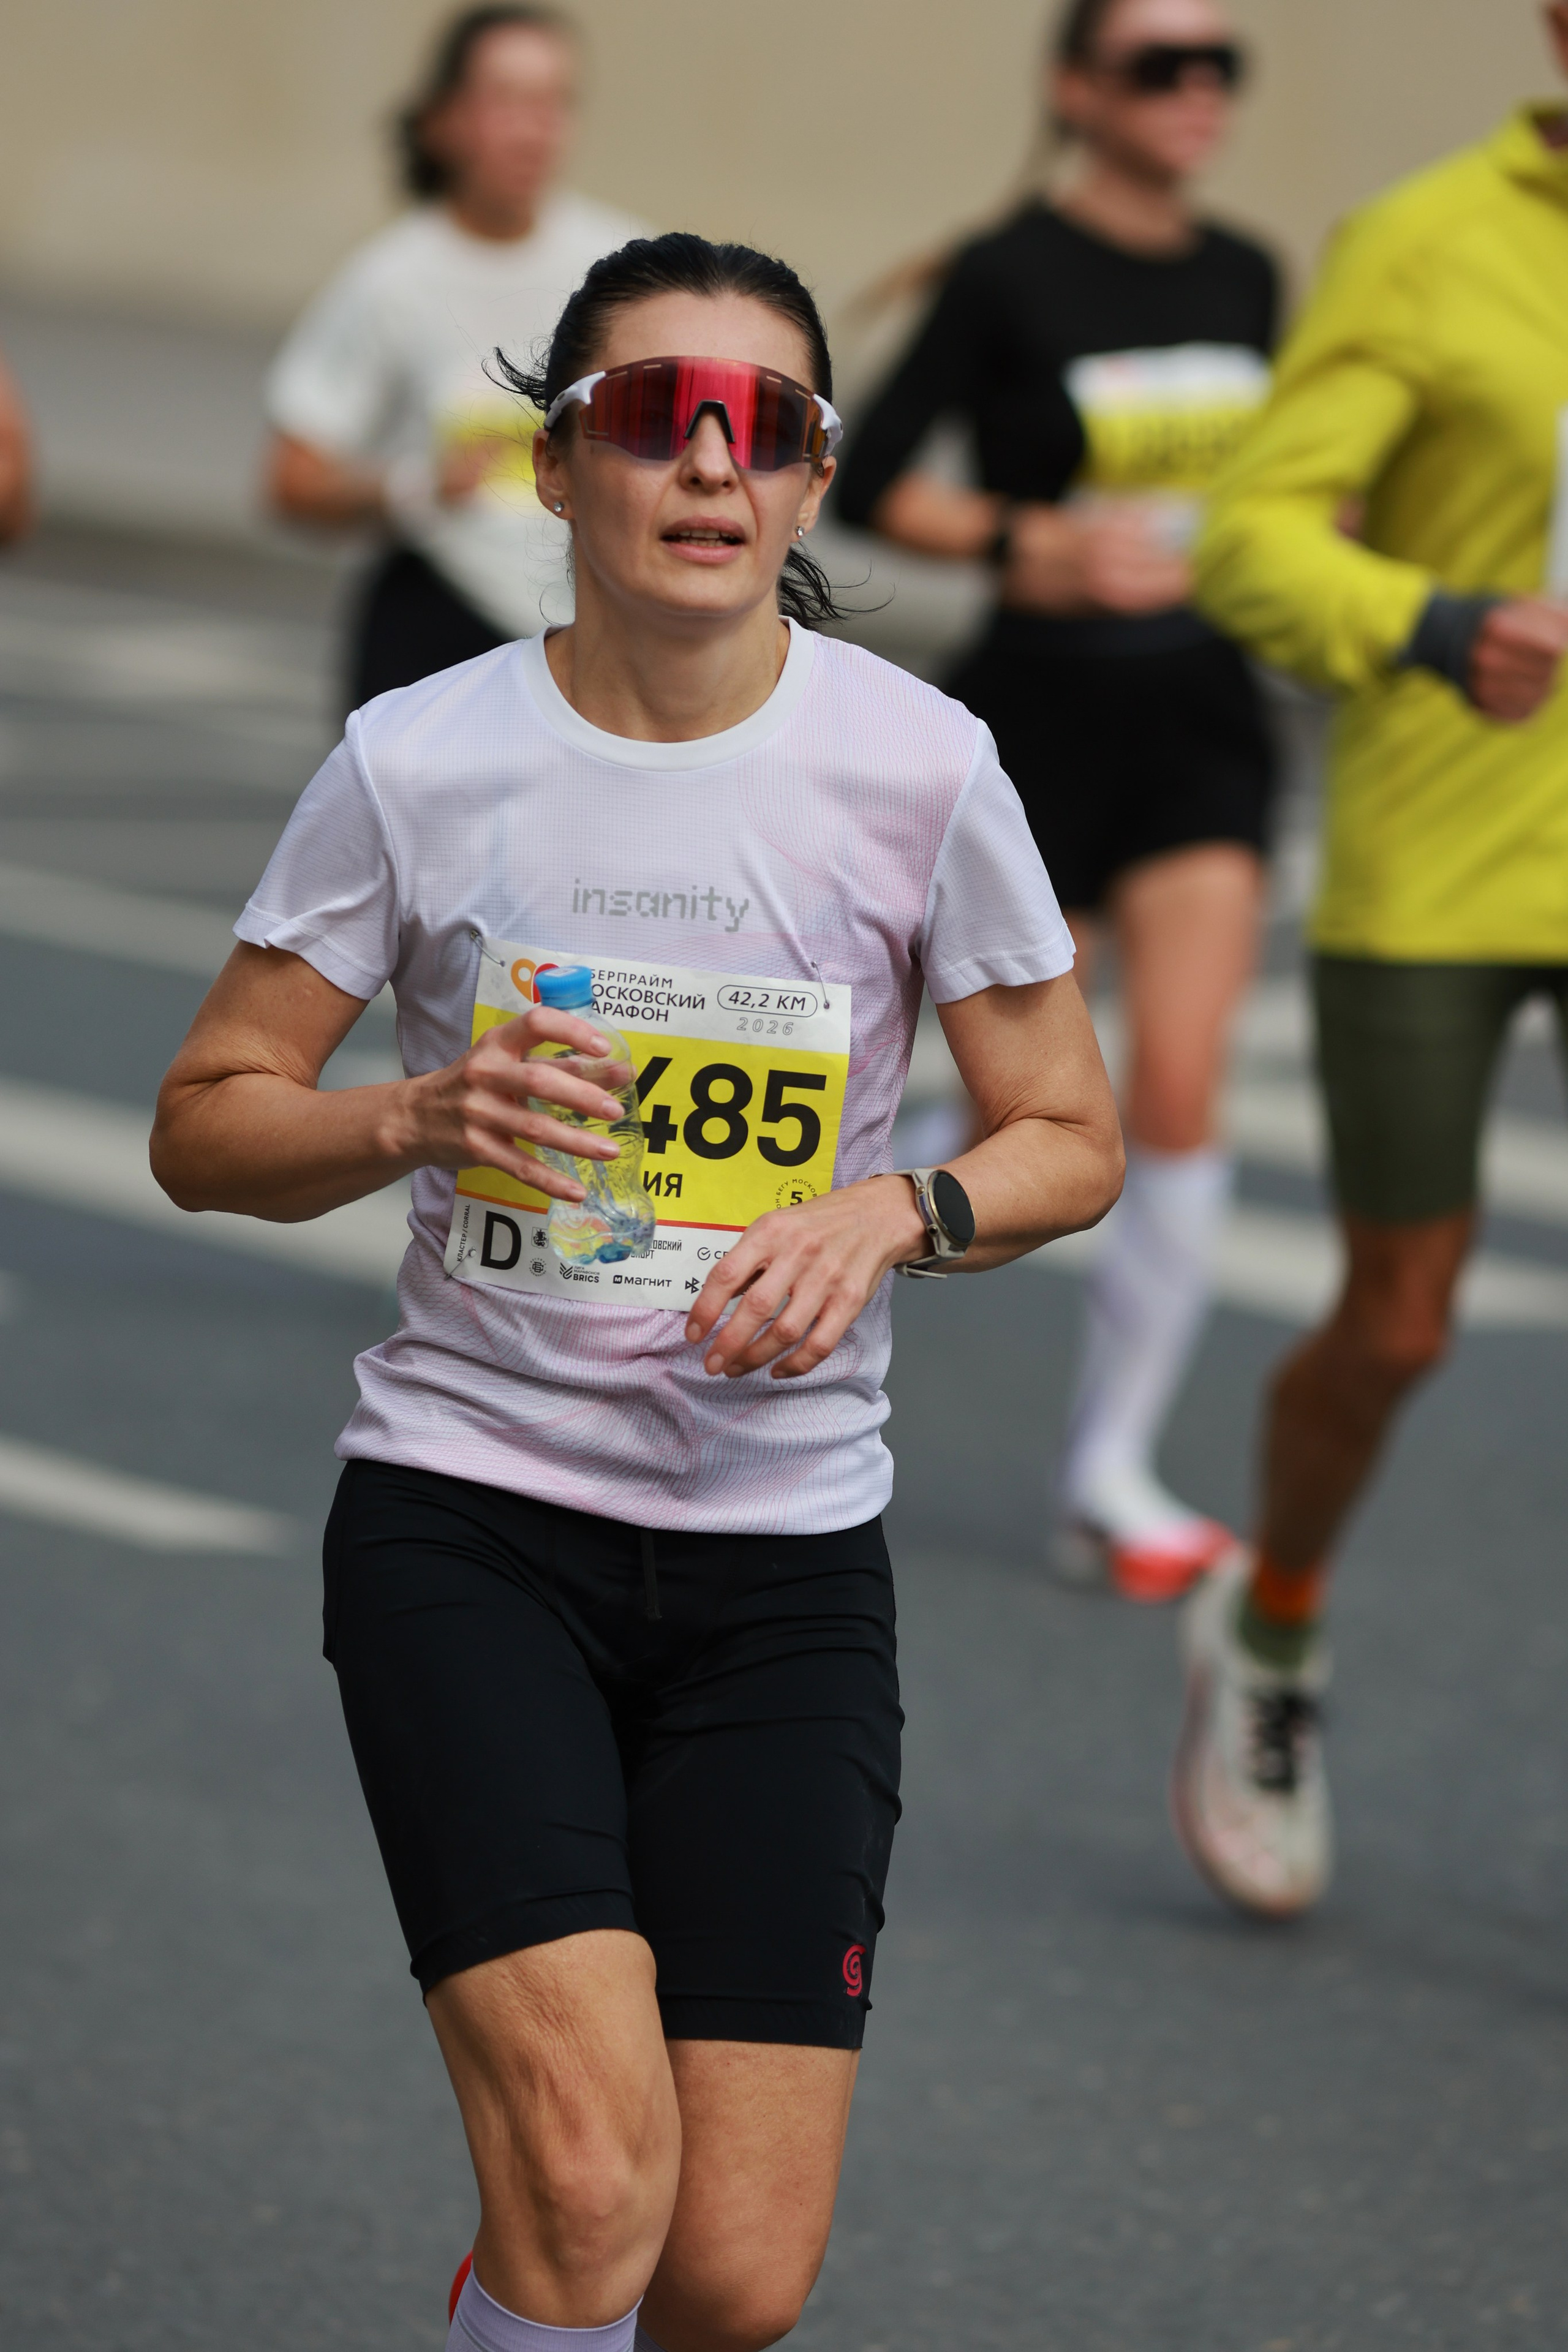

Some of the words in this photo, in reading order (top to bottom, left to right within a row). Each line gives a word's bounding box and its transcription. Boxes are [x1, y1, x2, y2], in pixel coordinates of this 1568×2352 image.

[573, 878, 749, 932] insanity
[590, 968, 673, 989] БЕРПРАЙМ
[592, 984, 706, 1010] ОСКОВСКИЙ
[728, 991, 769, 1008] 42,2
[777, 995, 806, 1011] КМ
[591, 1000, 669, 1022] АРАФОН
[736, 1017, 794, 1036] 2026
[611, 1056, 827, 1167] 485
[643, 1170, 683, 1198] ИЯ
[776, 1181, 788, 1196] БЕГУ
[792, 1178, 818, 1197] МОСКОВ
[790, 1191, 803, 1206] 5
[456, 1233, 467, 1262] КЛАСТЕР
[480, 1210, 522, 1270] D
[650, 1239, 682, 1251] ОВСКИЙ
[573, 1273, 600, 1283] BRICS
